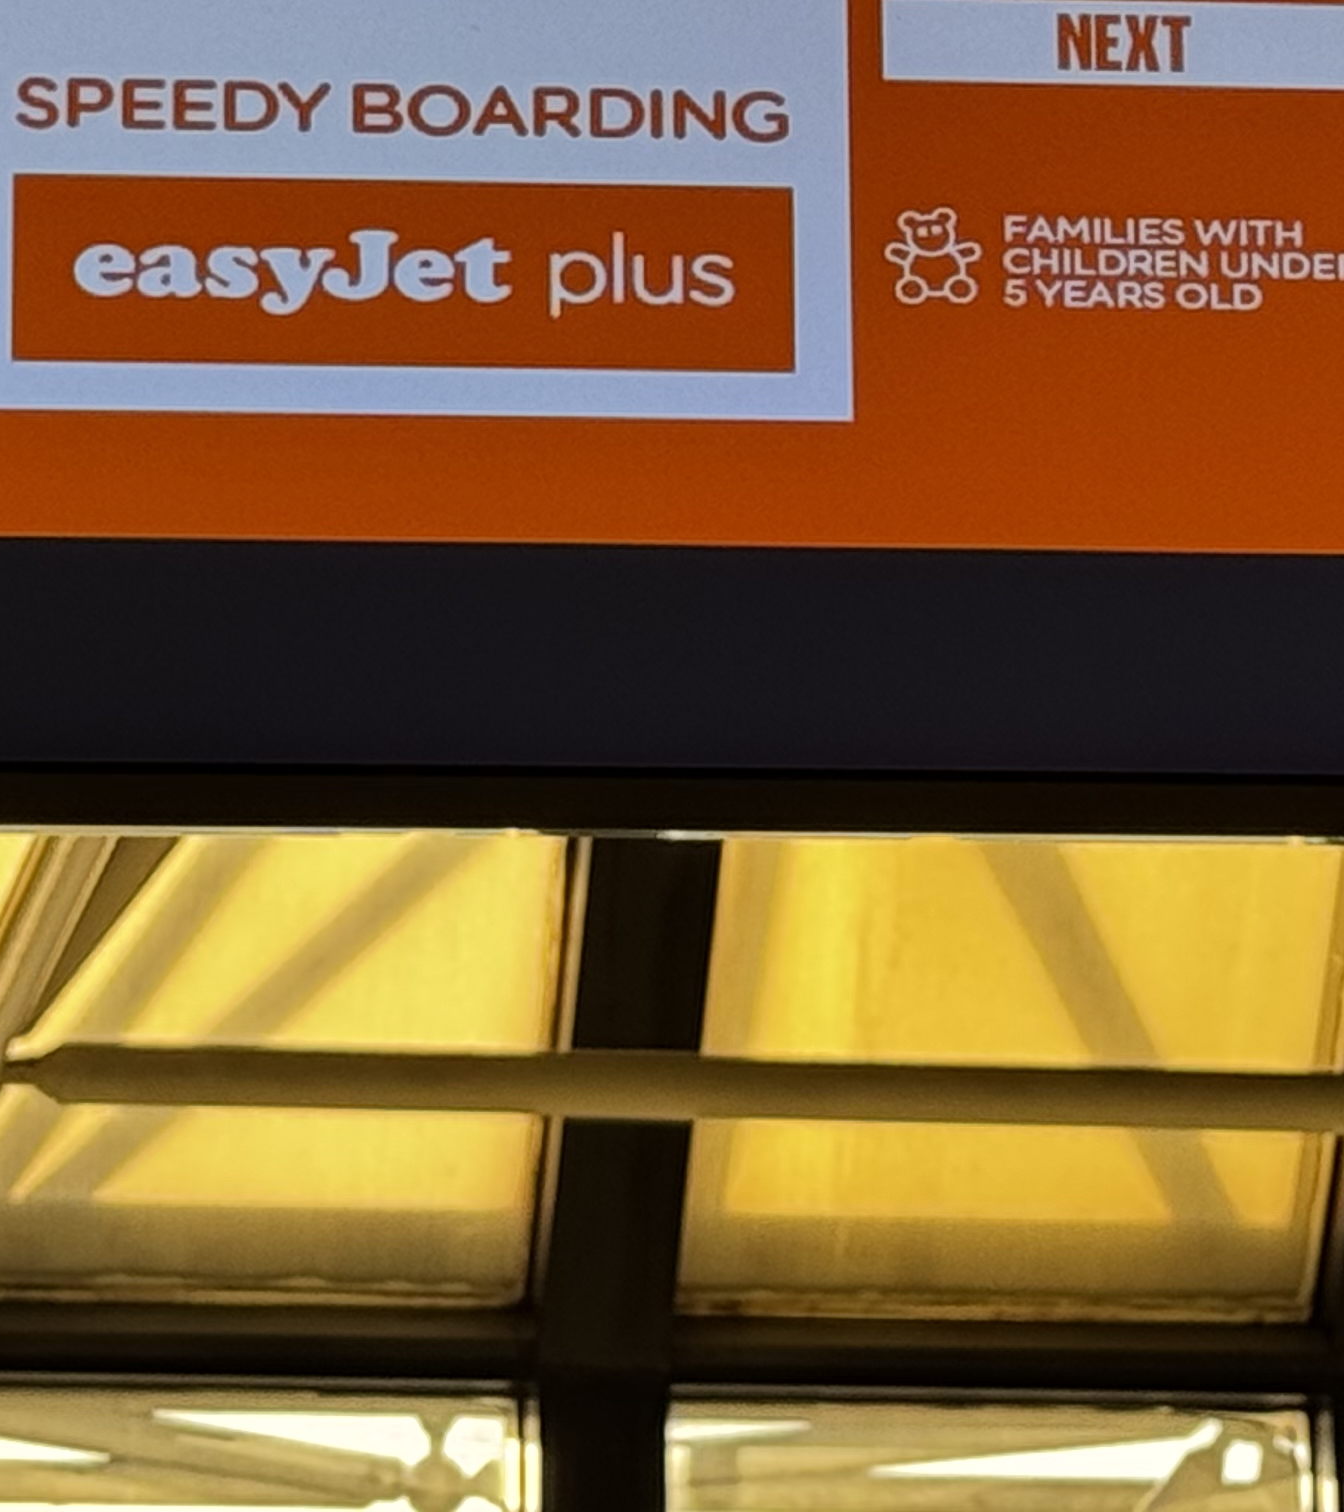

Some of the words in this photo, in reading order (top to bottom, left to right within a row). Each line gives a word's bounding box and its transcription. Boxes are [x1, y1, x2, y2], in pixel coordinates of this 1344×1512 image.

[1056, 12, 1192, 73] NEXT
[15, 76, 332, 133] SPEEDY
[351, 82, 791, 144] BOARDING
[1002, 213, 1185, 245] FAMILIES
[1193, 218, 1304, 248] WITH
[73, 229, 513, 316] easyJet
[548, 230, 737, 319] plus
[1002, 246, 1210, 278] CHILDREN
[1003, 278, 1028, 307] 5
[1035, 279, 1167, 309] YEARS
[1174, 282, 1264, 312] OLD
